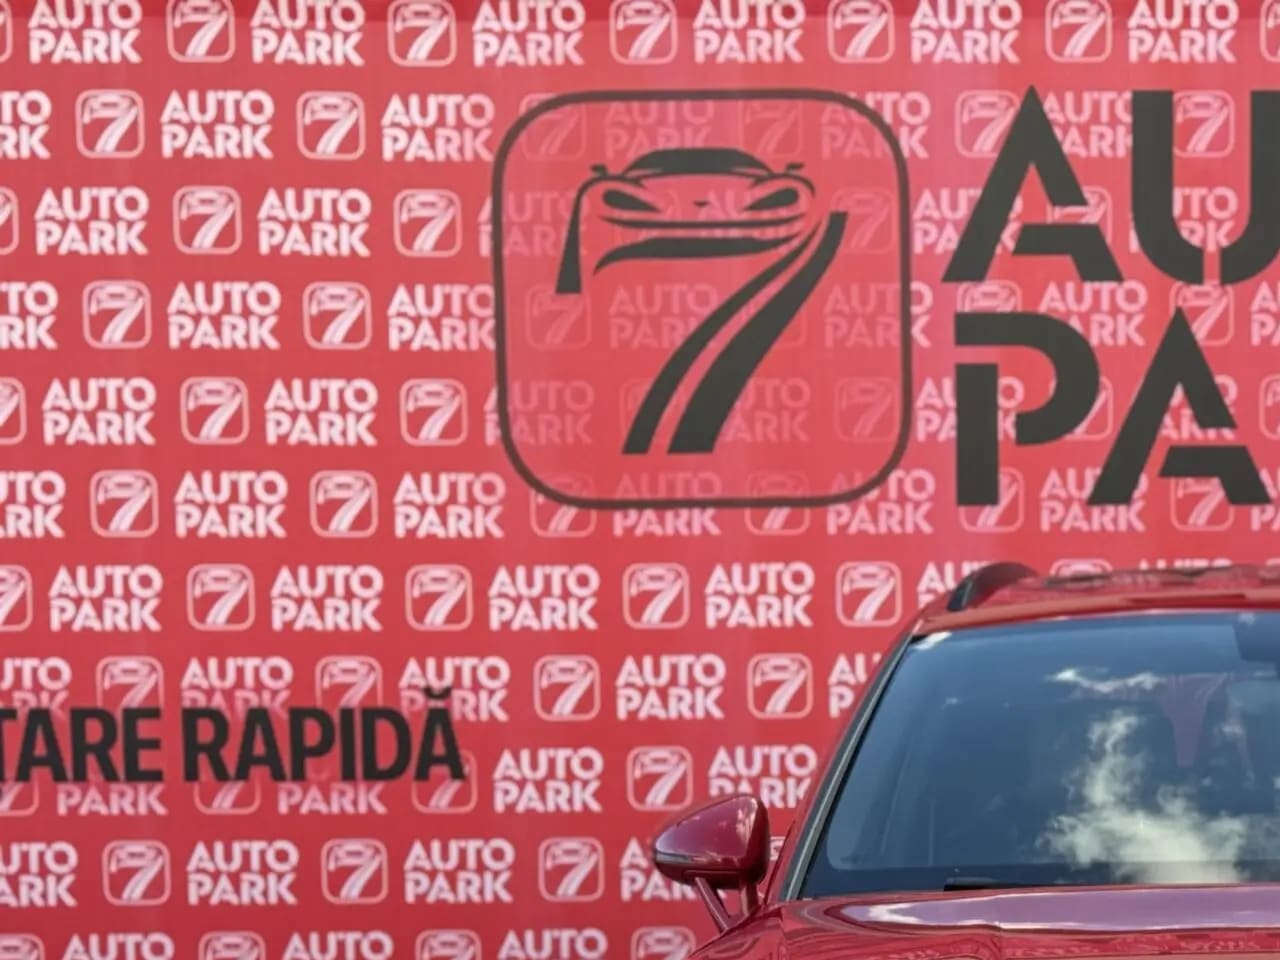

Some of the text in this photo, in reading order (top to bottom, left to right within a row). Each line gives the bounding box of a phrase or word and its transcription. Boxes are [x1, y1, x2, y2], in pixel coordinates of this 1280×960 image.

[29, 0, 141, 30] AUTO
[251, 0, 364, 31] AUTO
[472, 0, 584, 32] AUTO
[693, 0, 805, 29] AUTO
[910, 0, 1021, 30] AUTO
[1128, 0, 1238, 29] AUTO
[30, 29, 140, 63] PARK
[252, 31, 364, 66] PARK
[474, 31, 582, 66] PARK
[695, 28, 802, 63] PARK
[912, 29, 1018, 63] PARK
[1129, 28, 1235, 62] PARK
[161, 90, 274, 124] AUTO
[382, 94, 494, 128] AUTO
[162, 123, 272, 158] PARK
[383, 126, 492, 161] PARK
[35, 187, 148, 221] AUTO
[258, 188, 371, 222] AUTO
[36, 220, 147, 254] PARK
[259, 220, 369, 256] PARK
[168, 282, 281, 315] AUTO
[168, 314, 279, 349] PARK
[42, 378, 156, 411] AUTO
[265, 379, 378, 412] AUTO
[44, 410, 154, 444] PARK
[266, 410, 376, 445] PARK
[175, 471, 288, 504] AUTO
[394, 473, 505, 505] AUTO
[176, 503, 285, 537] PARK
[395, 504, 502, 538] PARK
[49, 565, 162, 598] AUTO
[271, 565, 383, 598] AUTO
[489, 565, 599, 598] AUTO
[705, 562, 814, 595] AUTO
[50, 597, 160, 631] PARK
[272, 597, 381, 631] PARK
[490, 597, 597, 630] PARK
[706, 594, 812, 628] PARK
[181, 656, 293, 690] AUTO
[399, 656, 510, 690] AUTO
[616, 654, 726, 687] AUTO
[617, 686, 723, 720] PARK
[182, 687, 466, 783] RAPIDĂ
[494, 748, 603, 781] AUTO
[494, 780, 601, 813] PARK
[187, 840, 299, 873] AUTO
[404, 838, 515, 871] AUTO
[188, 872, 296, 905] PARK
[405, 870, 512, 903] PARK
[498, 928, 607, 960] AUTO
